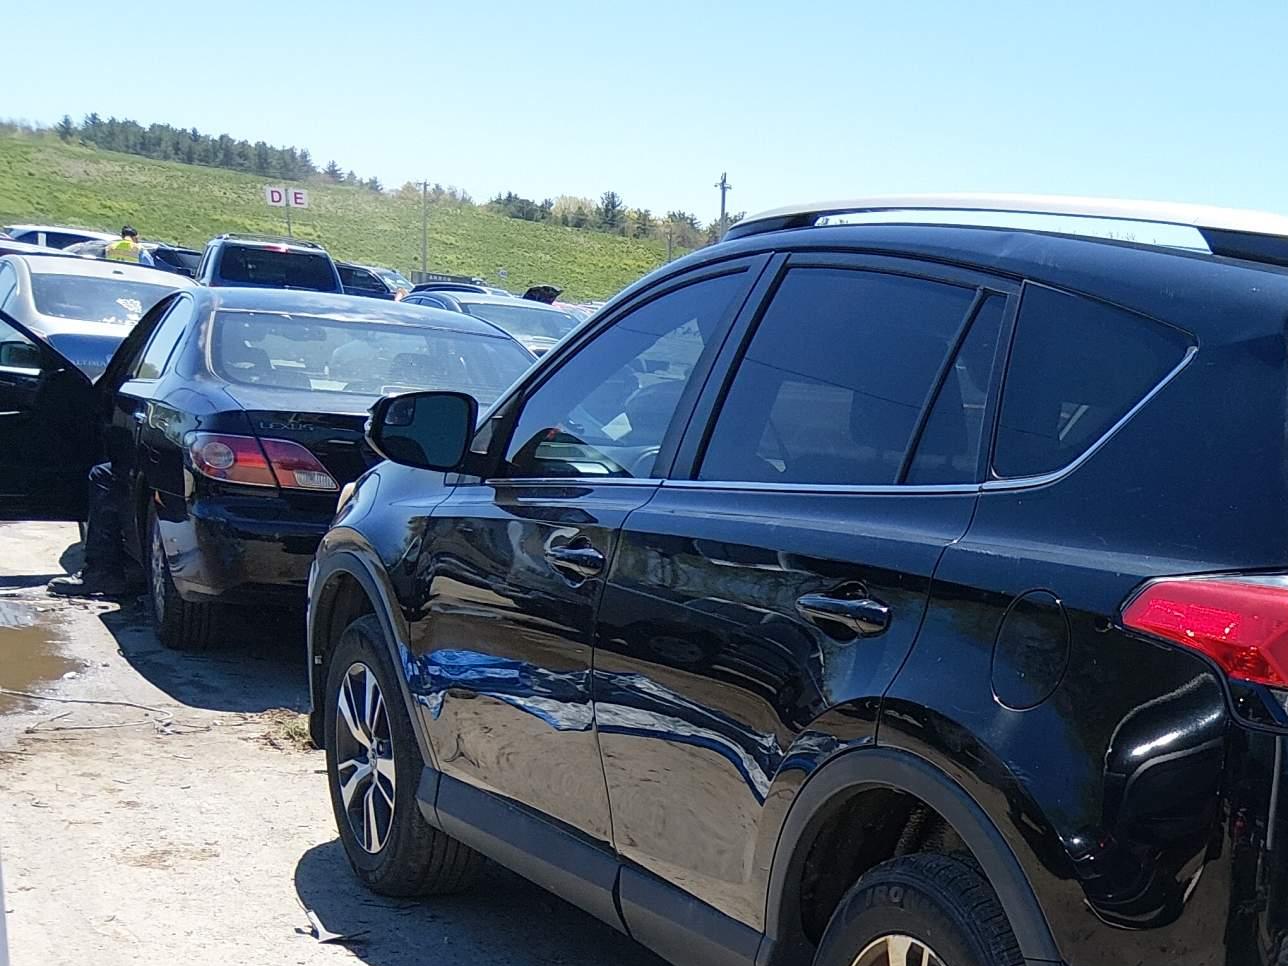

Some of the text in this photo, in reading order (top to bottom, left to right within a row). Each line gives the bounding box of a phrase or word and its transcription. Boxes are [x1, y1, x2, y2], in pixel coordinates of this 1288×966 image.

[271, 190, 282, 203] D
[294, 192, 304, 205] E
[260, 421, 314, 431] LEXUS
